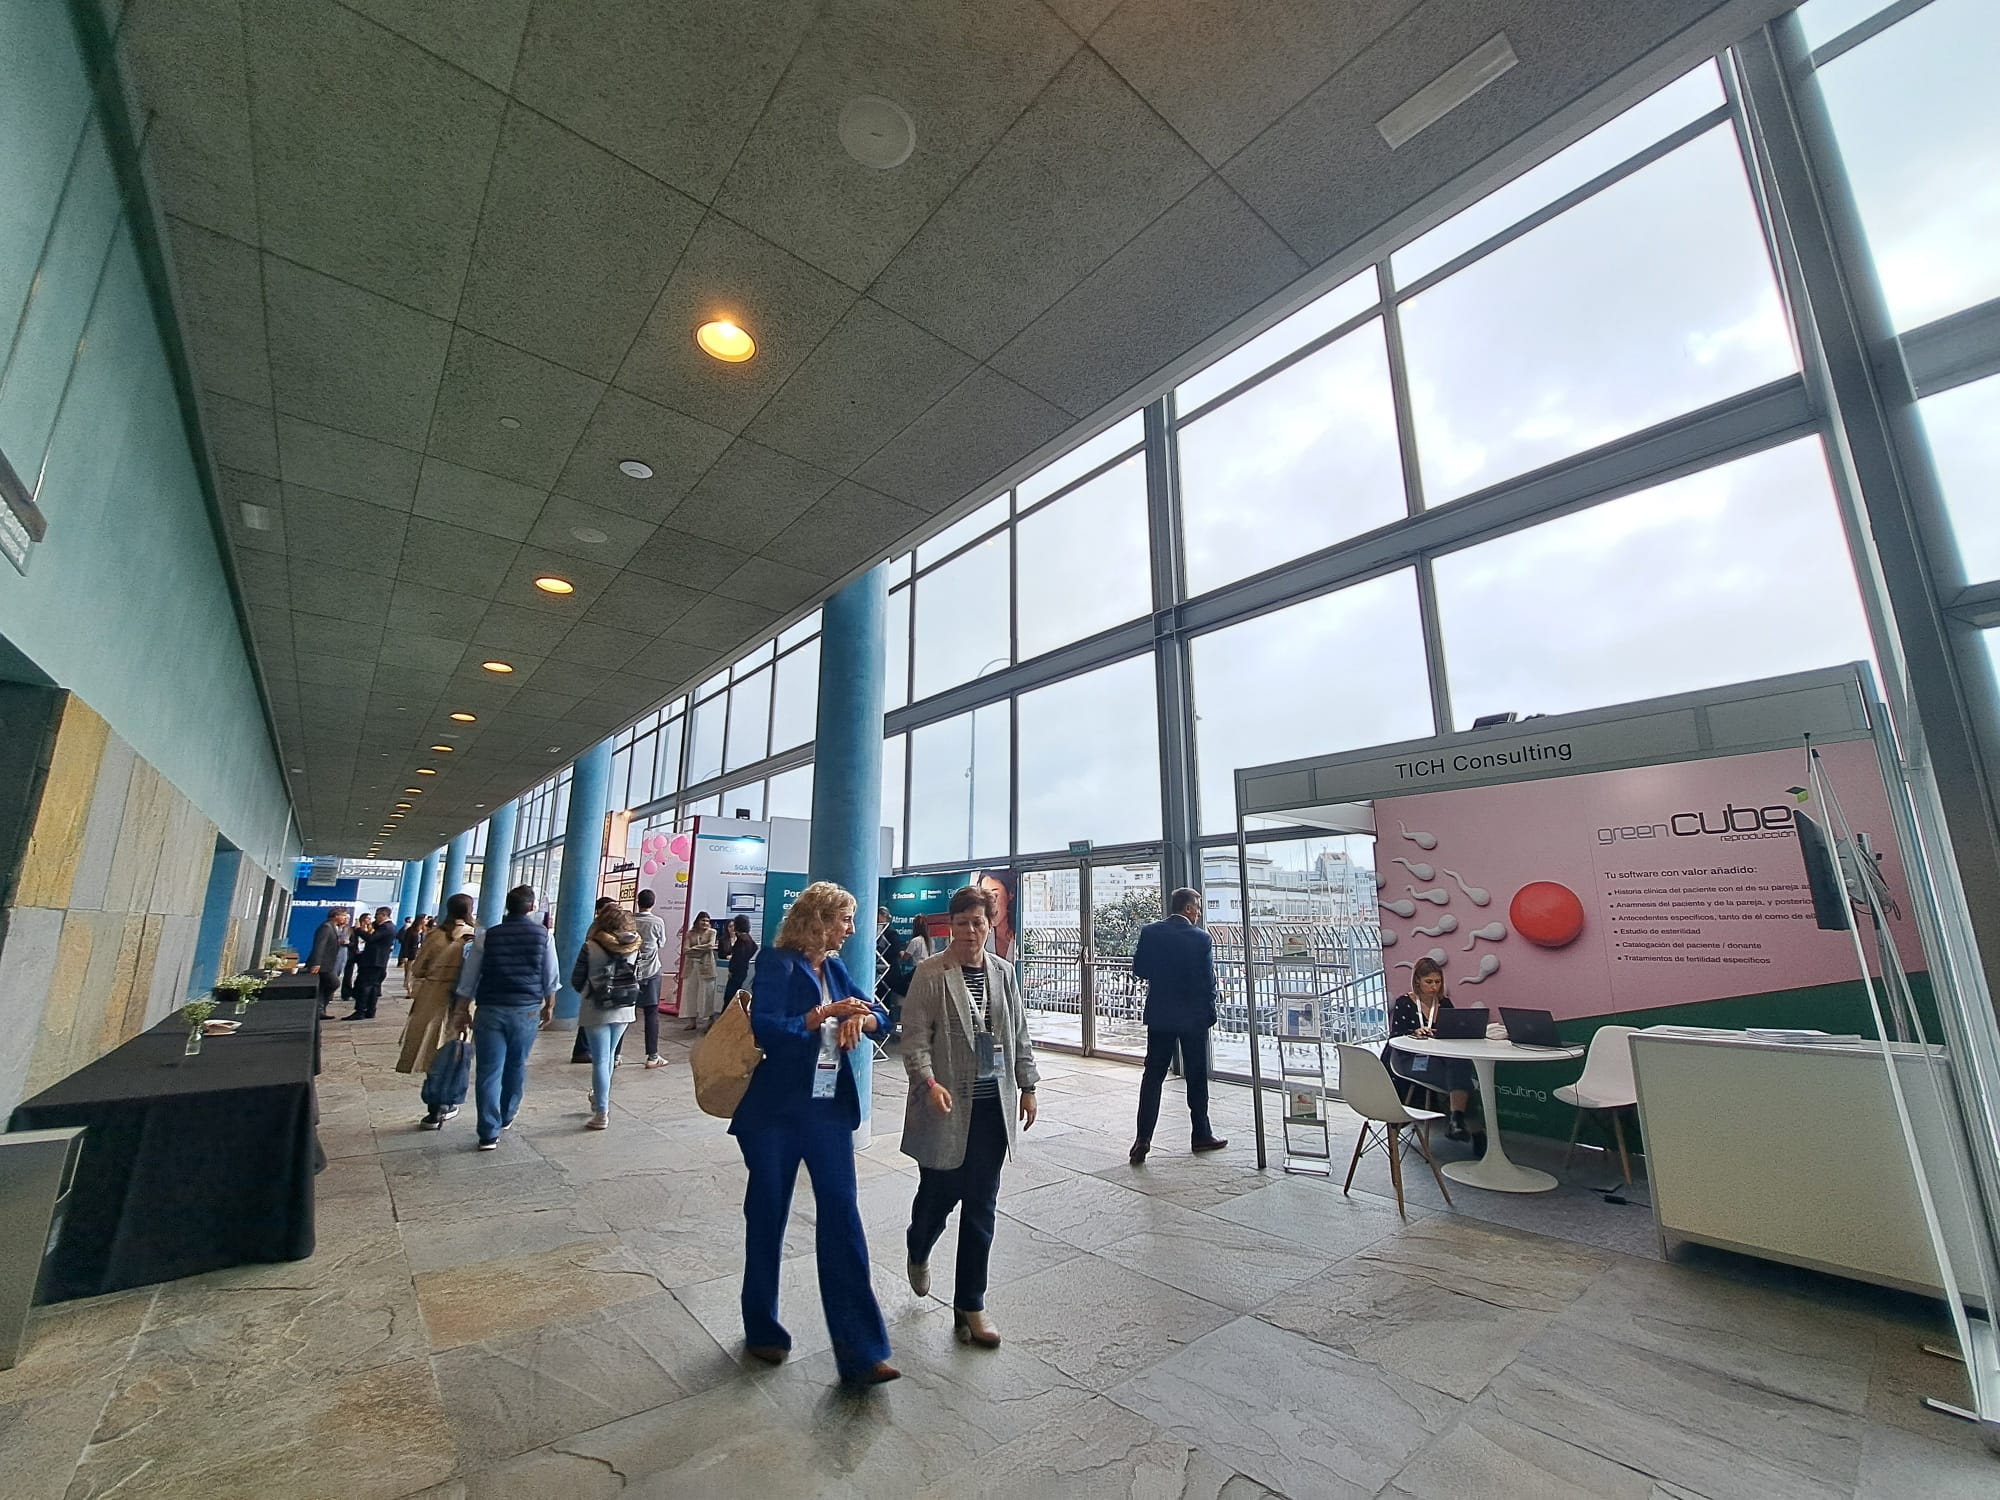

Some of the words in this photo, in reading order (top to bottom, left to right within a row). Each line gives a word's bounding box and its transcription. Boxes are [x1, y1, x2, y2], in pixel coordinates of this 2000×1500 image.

[1394, 758, 1445, 779] TICH
[1453, 743, 1572, 771] Consulting
[1597, 823, 1669, 845] green
[1670, 803, 1795, 837] cube
[1720, 829, 1797, 842] reproducción
[1619, 871, 1659, 879] software
[1661, 869, 1679, 877] con
[1681, 868, 1708, 876] valor
[1710, 866, 1758, 875] añadido:
[1682, 886, 1717, 894] paciente
[1771, 883, 1799, 891] pareja
[1622, 941, 1671, 949] Catalogación
